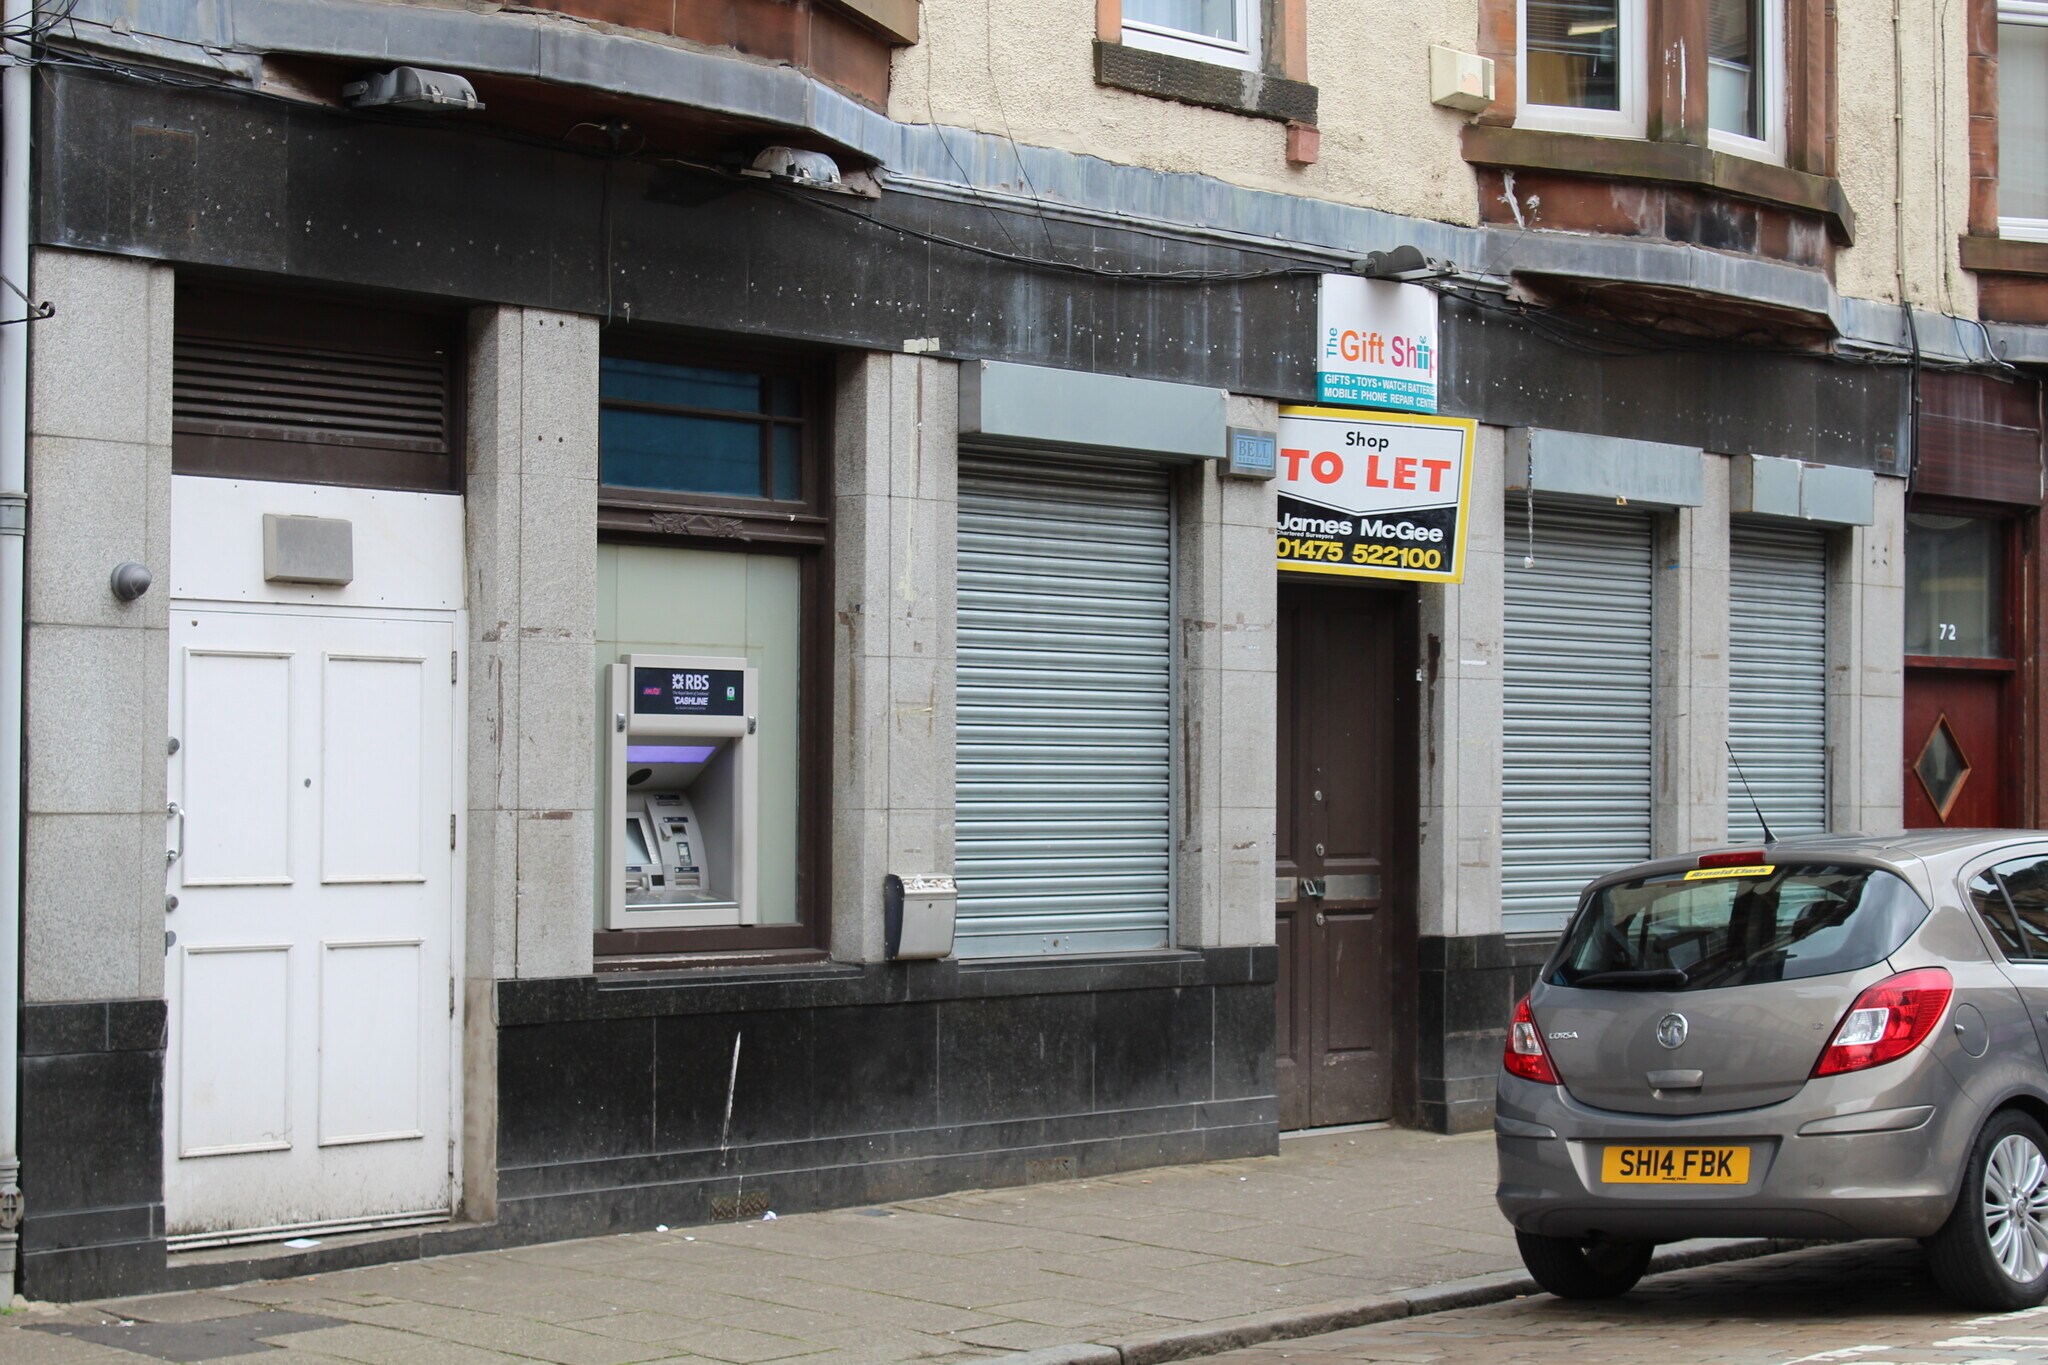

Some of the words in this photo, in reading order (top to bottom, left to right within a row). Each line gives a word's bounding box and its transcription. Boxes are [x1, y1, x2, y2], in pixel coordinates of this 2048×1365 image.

[1326, 327, 1338, 358] The
[1340, 330, 1385, 365] Gift
[1324, 373, 1350, 385] GIFTS
[1356, 376, 1378, 389] TOYS
[1382, 380, 1408, 393] WATCH
[1324, 387, 1358, 400] MOBILE
[1360, 391, 1388, 403] PHONE
[1390, 393, 1415, 406] REPAIR
[1415, 396, 1438, 410] CENTRE
[1238, 440, 1270, 459] BELL
[1345, 431, 1390, 453] Shop
[1280, 448, 1344, 485] TO
[1366, 455, 1452, 493] LET
[1277, 512, 1353, 536] James
[1360, 518, 1444, 543] McGee
[1305, 532, 1334, 540] Surveyors
[1277, 537, 1344, 562] 01475
[1351, 543, 1442, 570] 522100
[1939, 623, 1957, 641] 72
[685, 674, 710, 691] RBS
[673, 696, 709, 706] CASHLINE
[1548, 1031, 1579, 1040] CORSA
[1619, 1149, 1675, 1177] SH14
[1682, 1149, 1734, 1177] FBK
